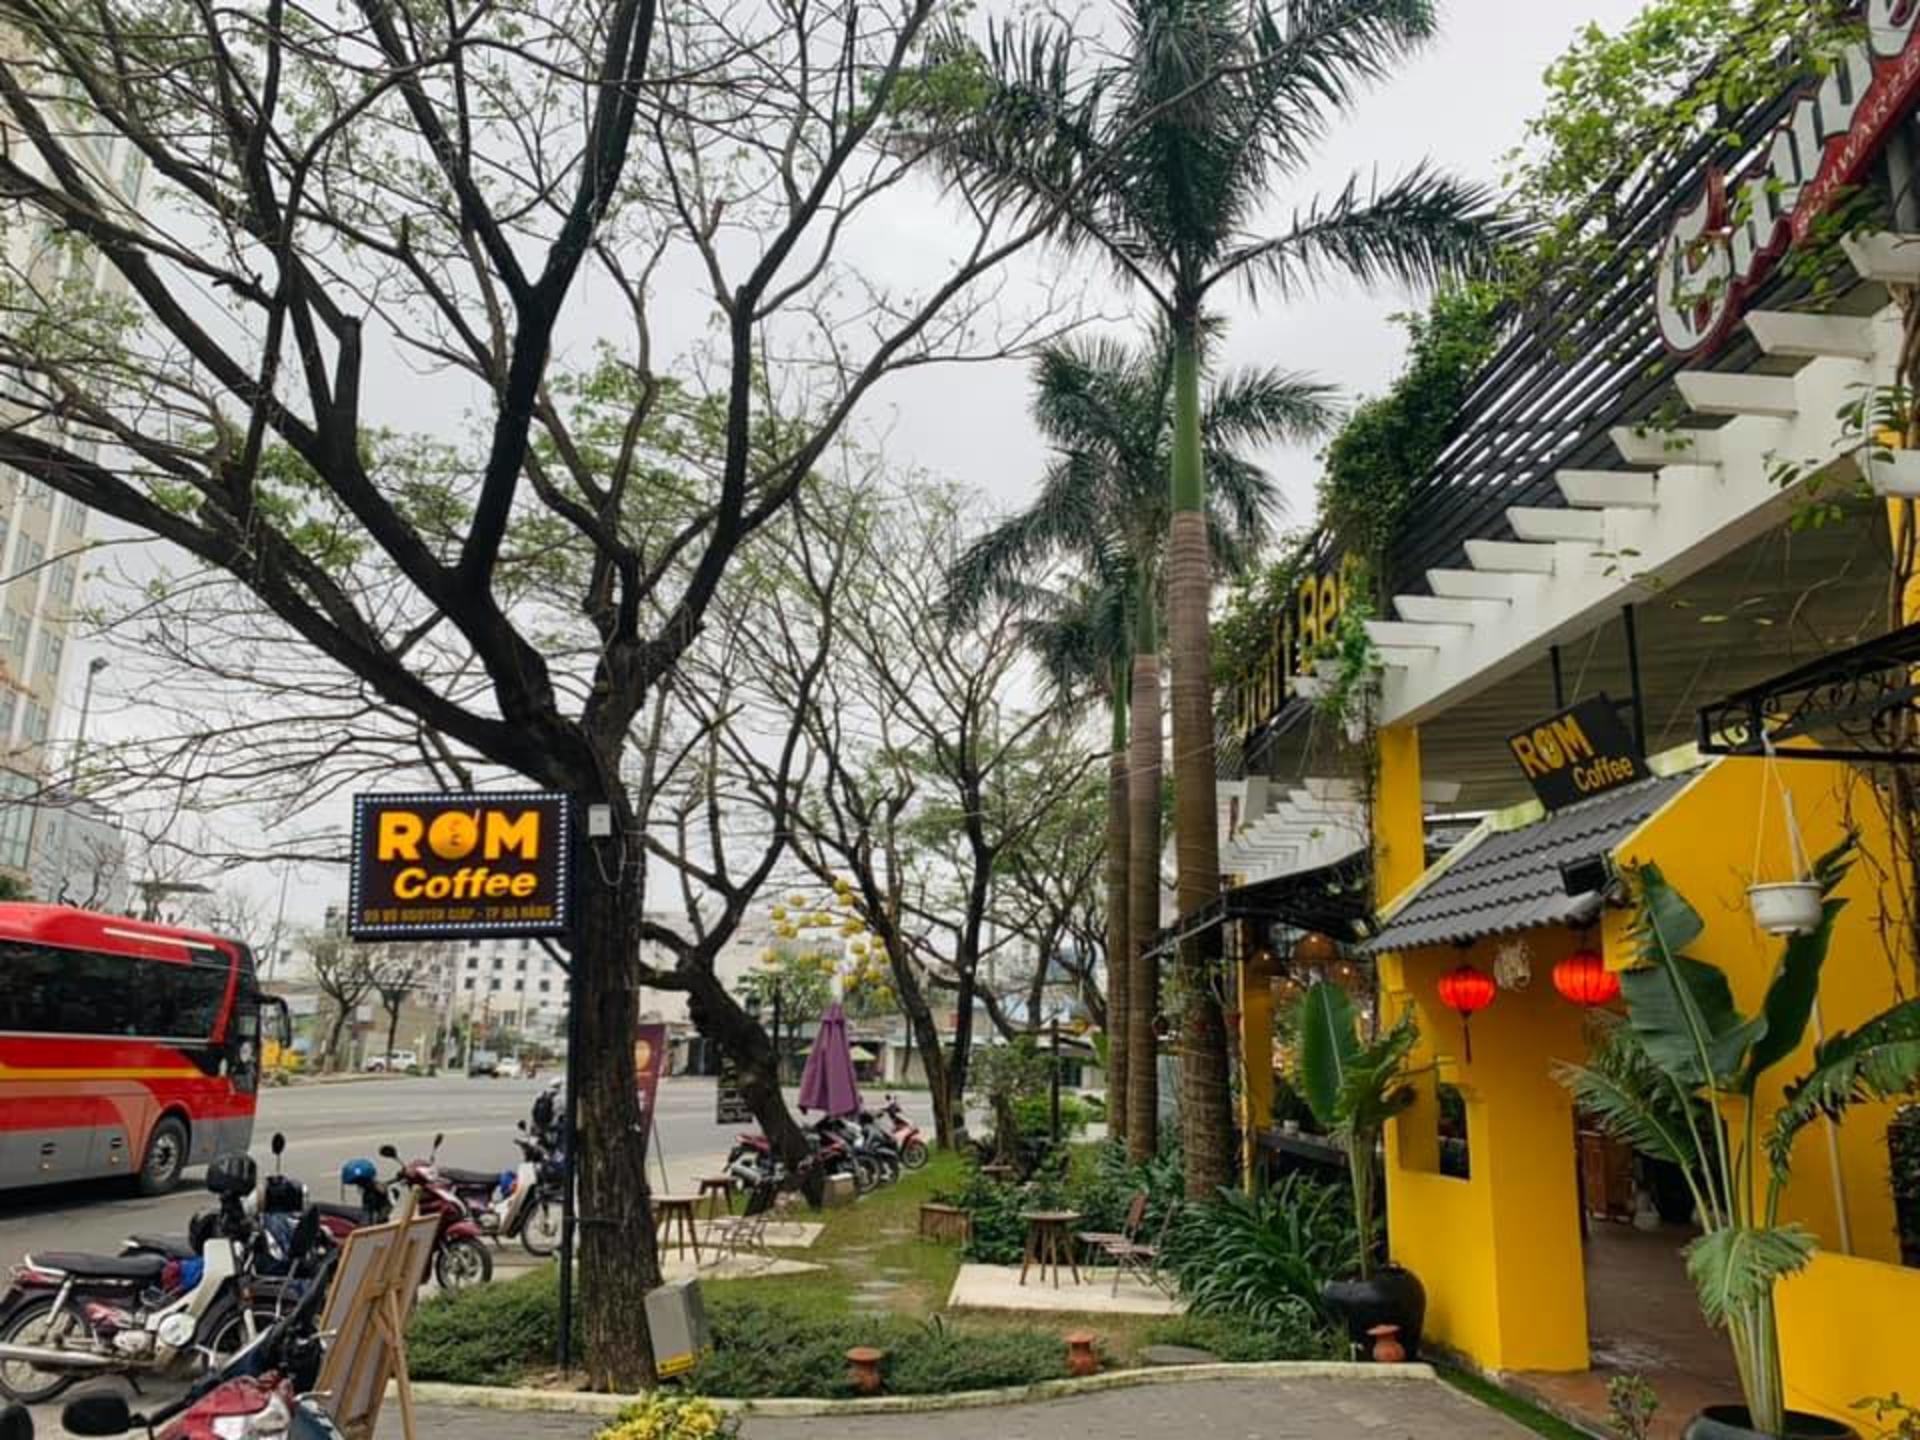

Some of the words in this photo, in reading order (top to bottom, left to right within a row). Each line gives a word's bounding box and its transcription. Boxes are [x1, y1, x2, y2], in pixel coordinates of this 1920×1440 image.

[1511, 714, 1594, 778] ROM
[1573, 756, 1634, 792] Coffee
[378, 809, 540, 861] ROM
[393, 867, 538, 899] Coffee
